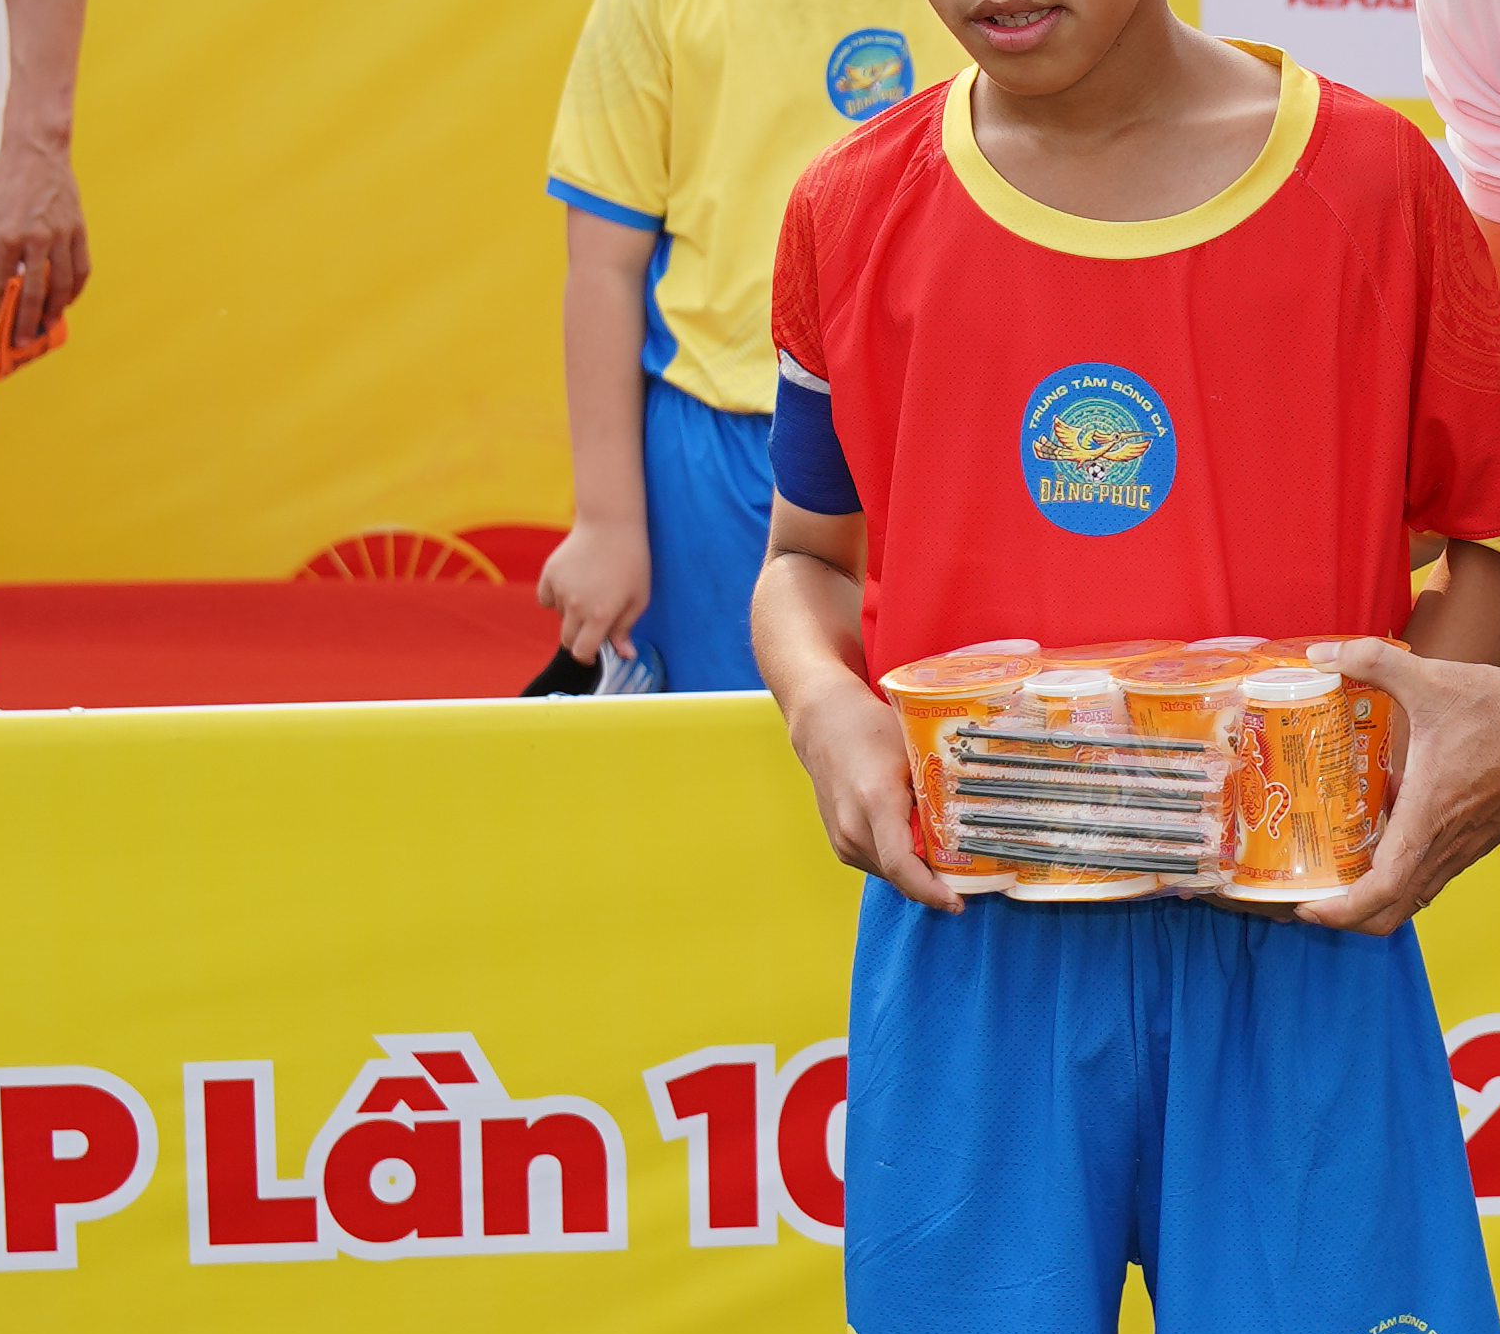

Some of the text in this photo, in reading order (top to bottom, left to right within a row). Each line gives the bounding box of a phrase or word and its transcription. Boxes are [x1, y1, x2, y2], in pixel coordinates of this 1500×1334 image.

[1028, 375, 1169, 439] TRUNG TÂM BÓNG ĐÁ
[1039, 473, 1152, 511] ĐĂNG PHÚC
[931, 706, 969, 718] Drink
[202, 1049, 610, 1247] Lần
